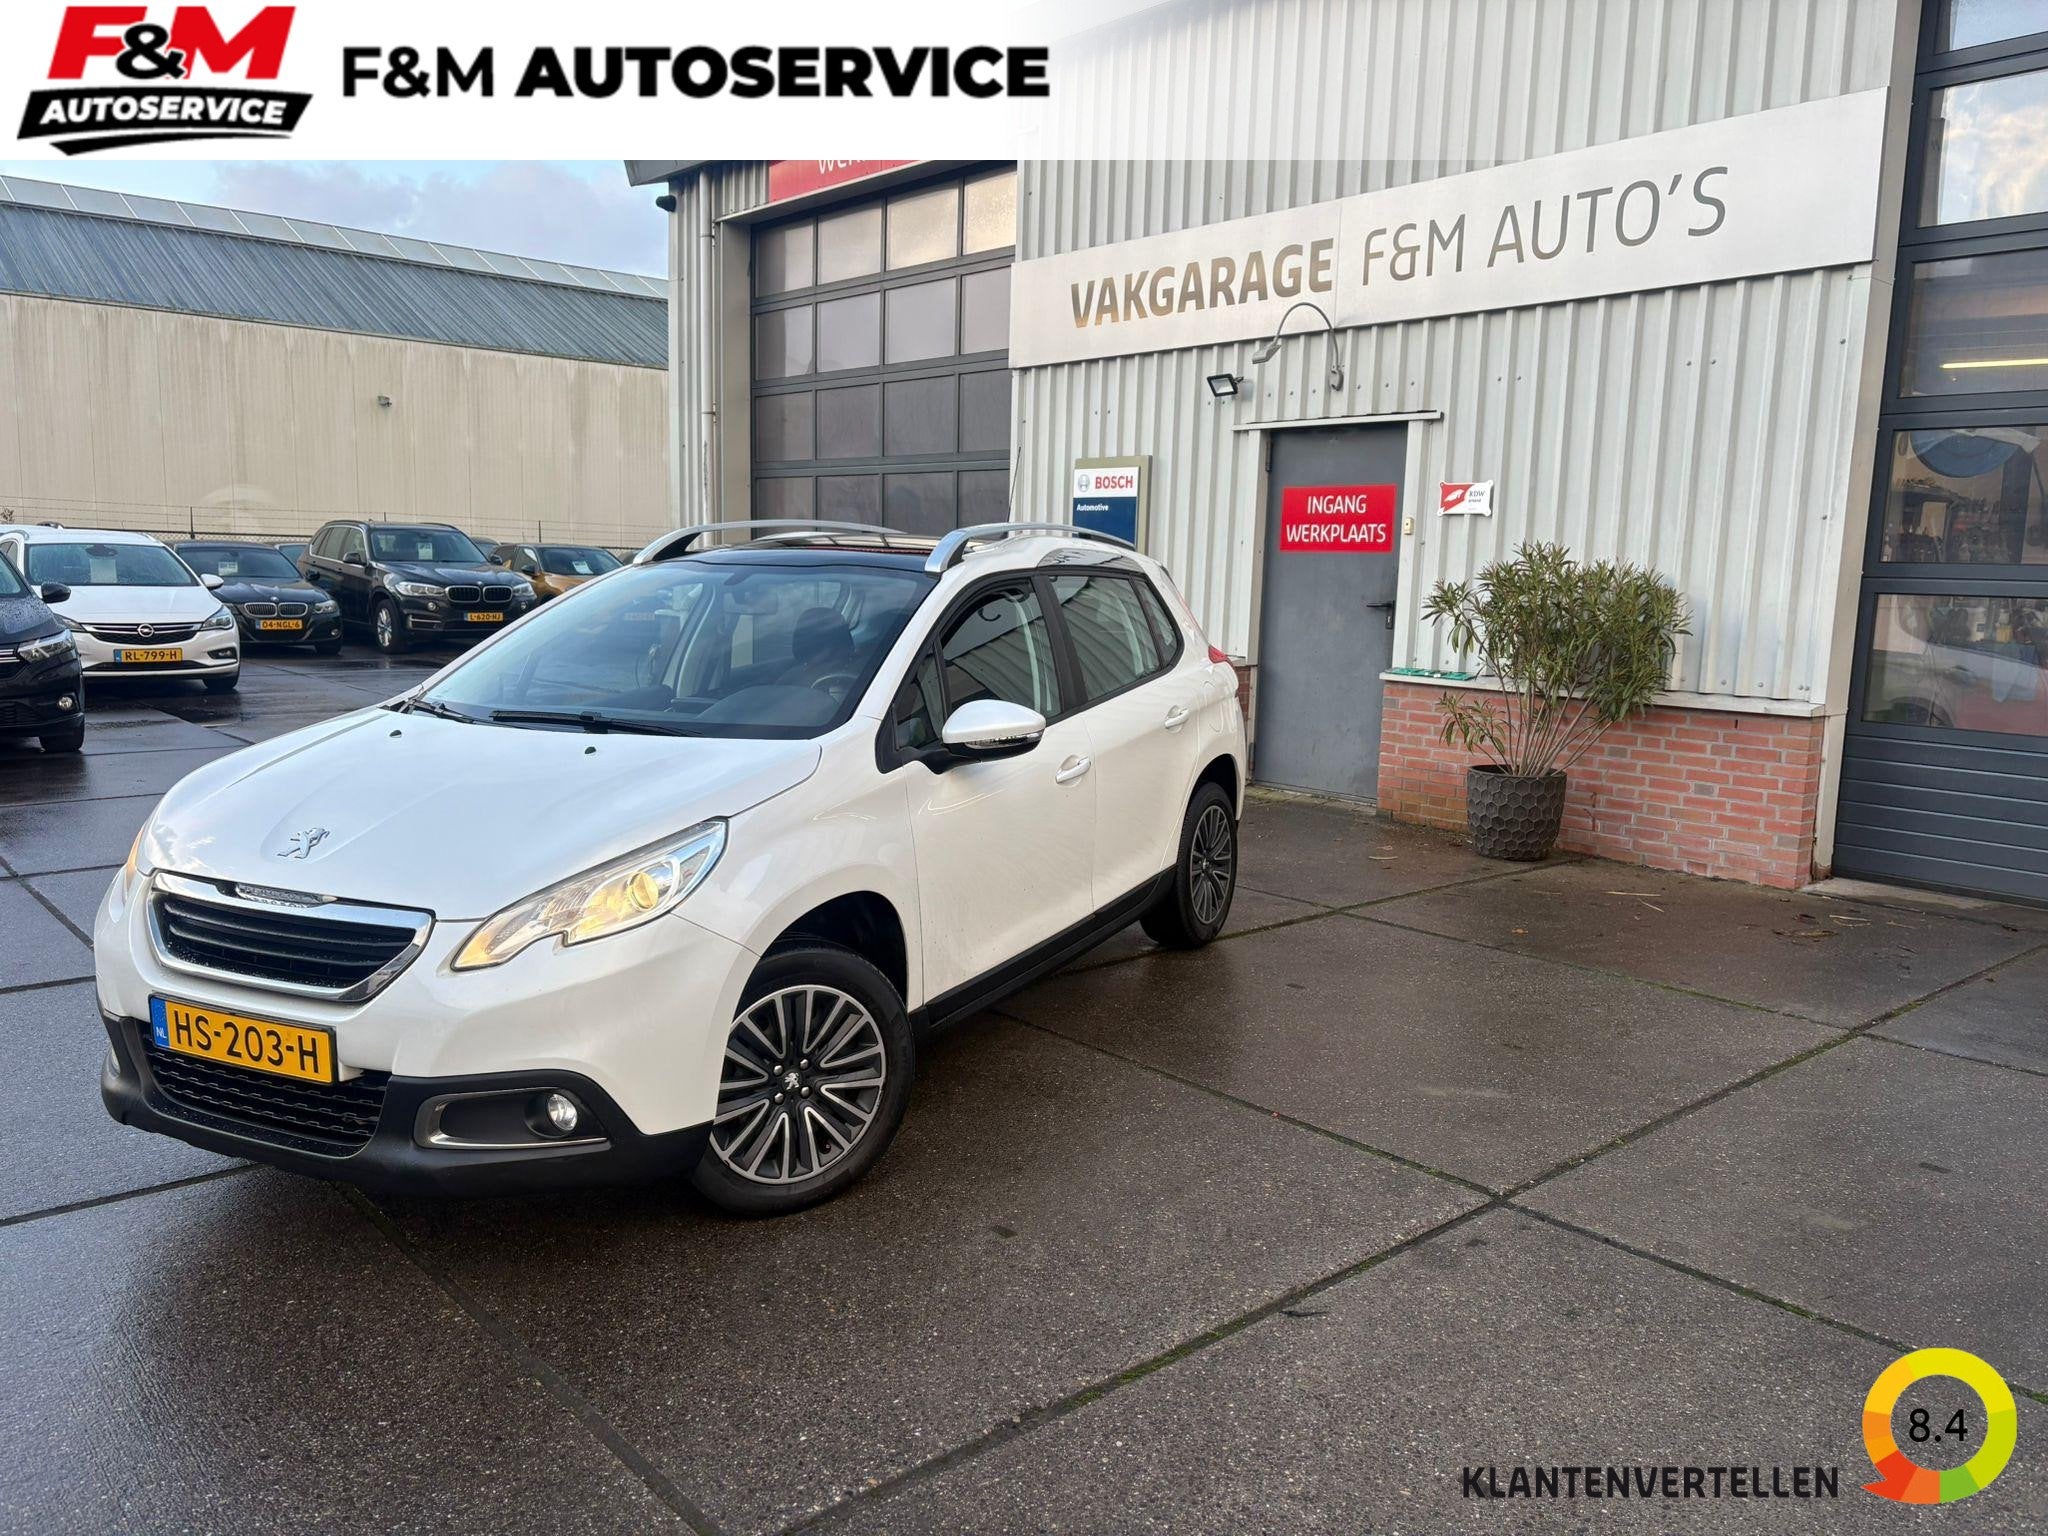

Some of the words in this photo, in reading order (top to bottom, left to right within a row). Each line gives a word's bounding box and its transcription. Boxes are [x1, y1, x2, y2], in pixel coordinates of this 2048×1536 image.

[1070, 238, 1334, 328] VAKGARAGE
[1362, 213, 1467, 287] F&M
[1487, 166, 1728, 268] AUTO'S
[1095, 475, 1134, 489] BOSCH
[1076, 503, 1109, 511] Automotive
[1307, 495, 1367, 514] INGANG
[1286, 524, 1386, 543] WERKPLAATS
[262, 621, 300, 629] 04-NGL-6
[125, 650, 177, 661] RL-799-H
[156, 1027, 167, 1039] NL
[174, 1010, 319, 1074] HS-203-H
